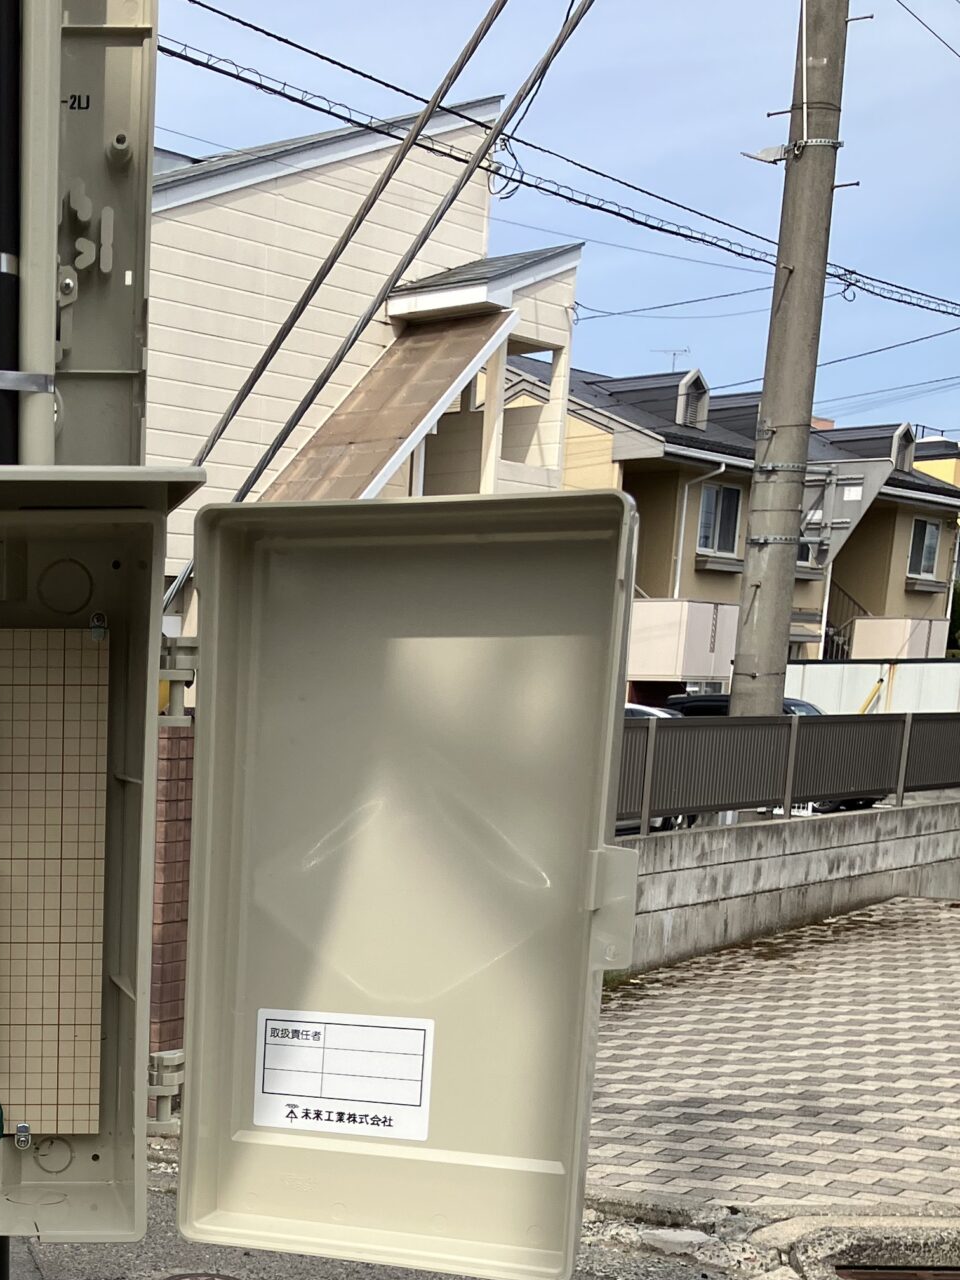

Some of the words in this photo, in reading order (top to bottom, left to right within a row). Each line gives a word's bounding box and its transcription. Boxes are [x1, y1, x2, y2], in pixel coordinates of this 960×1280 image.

[270, 1027, 322, 1042] 取扱責任者
[301, 1108, 394, 1128] 未来工業株式会社
